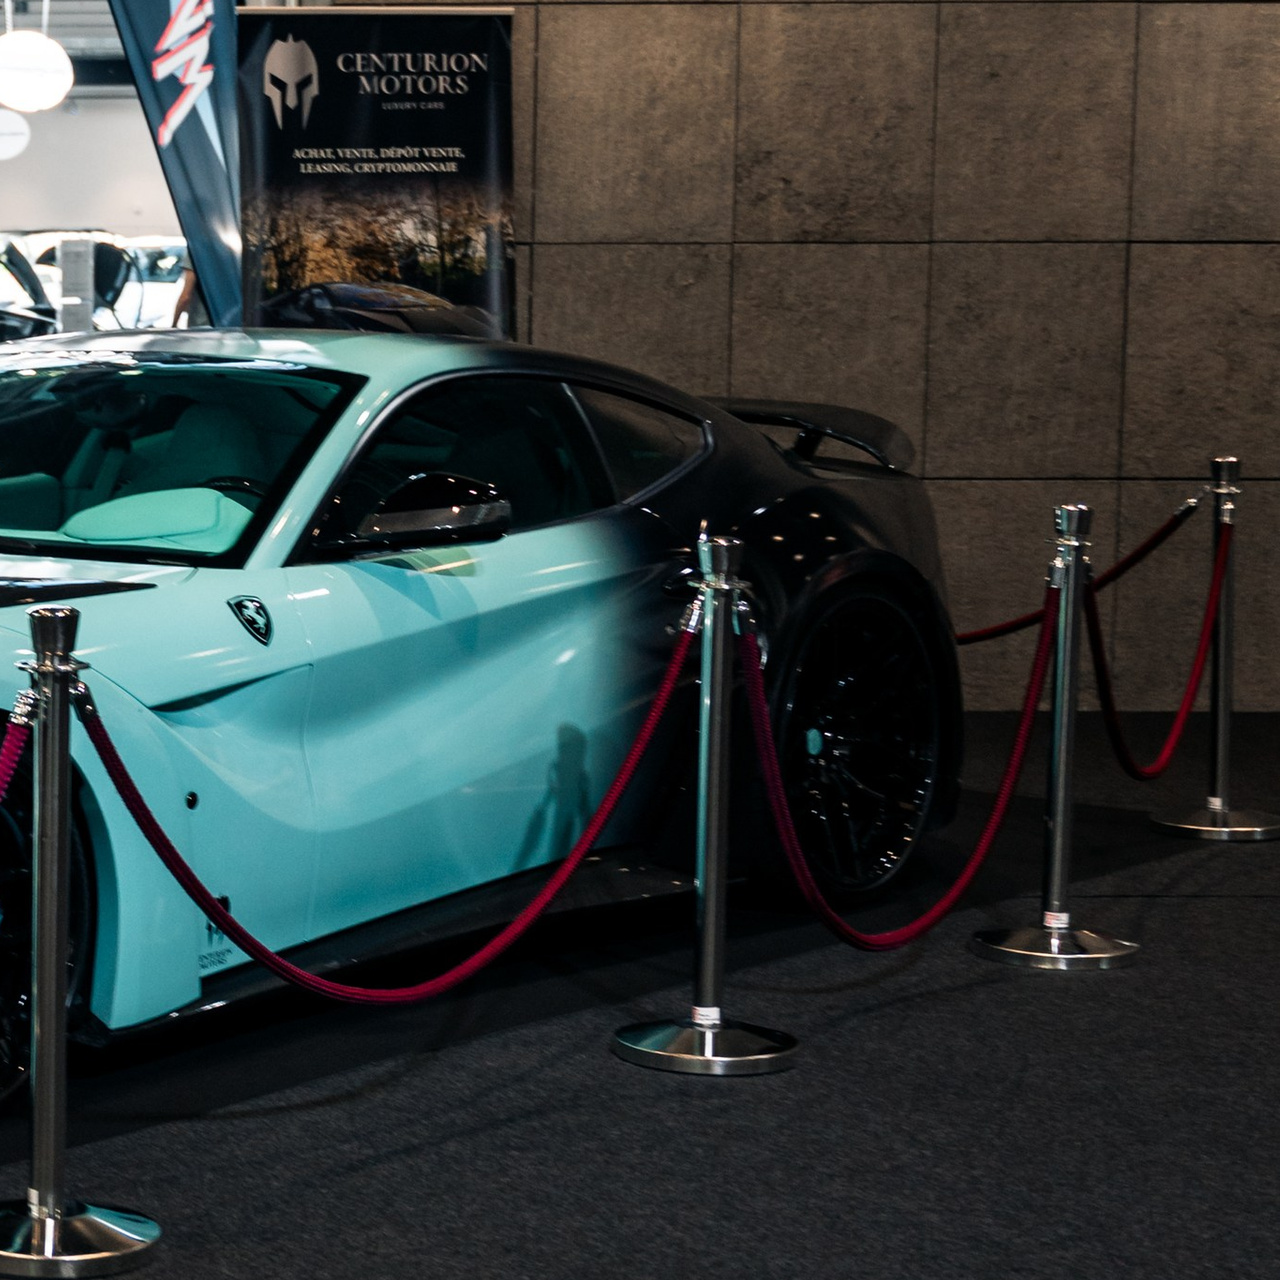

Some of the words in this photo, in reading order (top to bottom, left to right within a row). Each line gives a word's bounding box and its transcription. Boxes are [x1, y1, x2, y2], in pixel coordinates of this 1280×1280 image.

[335, 52, 489, 74] CENTURION
[358, 74, 470, 95] MOTORS
[354, 162, 459, 174] CRYPTOMONNAIE
